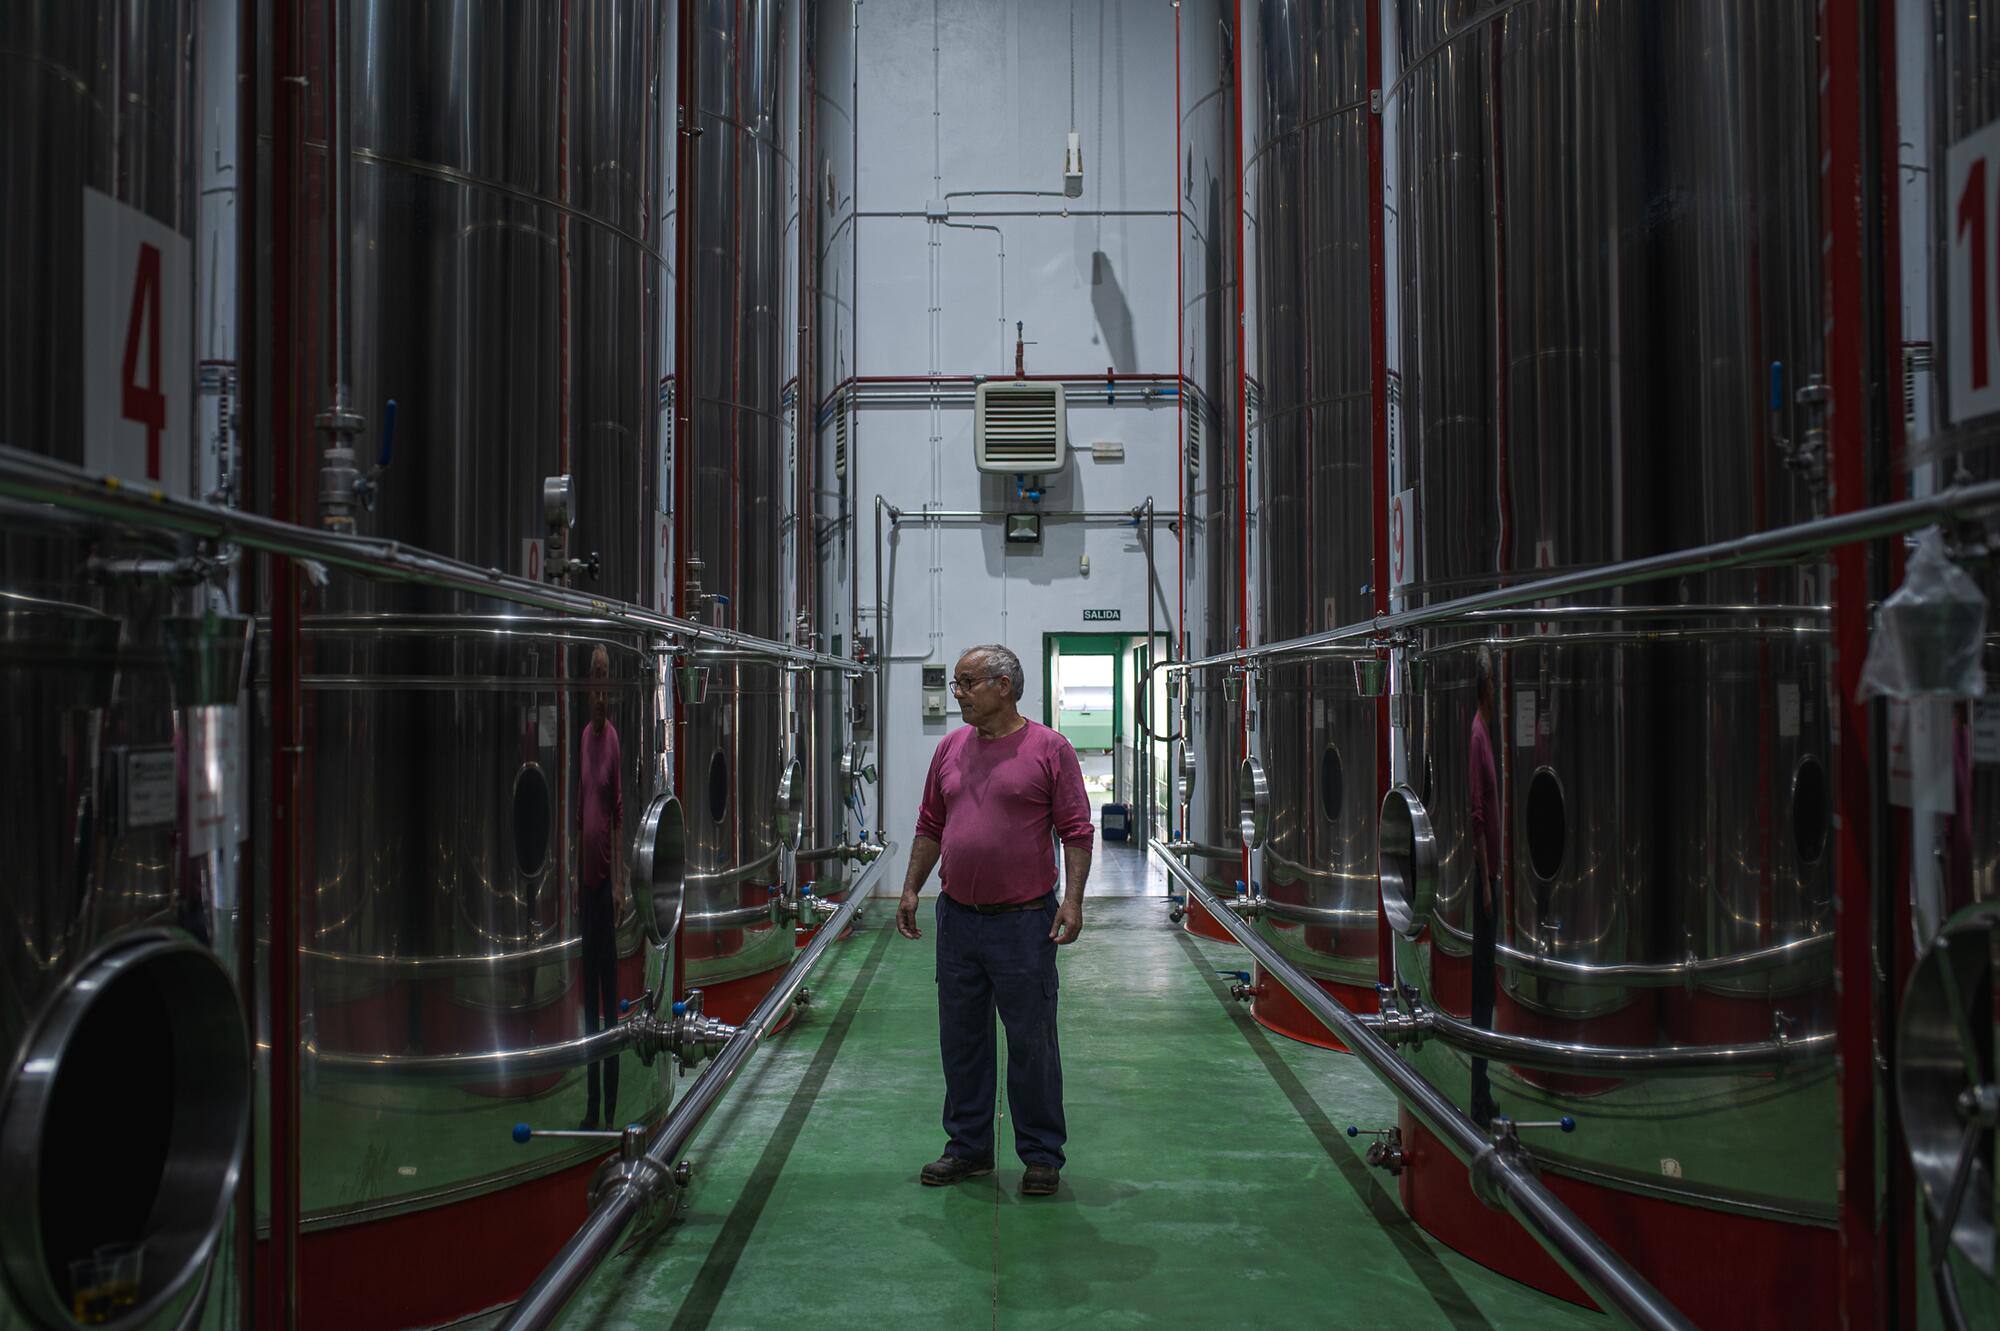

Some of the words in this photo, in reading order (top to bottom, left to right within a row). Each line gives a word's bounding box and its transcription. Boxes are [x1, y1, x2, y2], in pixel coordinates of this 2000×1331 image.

[1957, 156, 2000, 391] 1
[122, 242, 165, 481] 4
[660, 523, 669, 616] 3
[1393, 496, 1404, 584] 9
[1084, 610, 1120, 619] SALIDA
